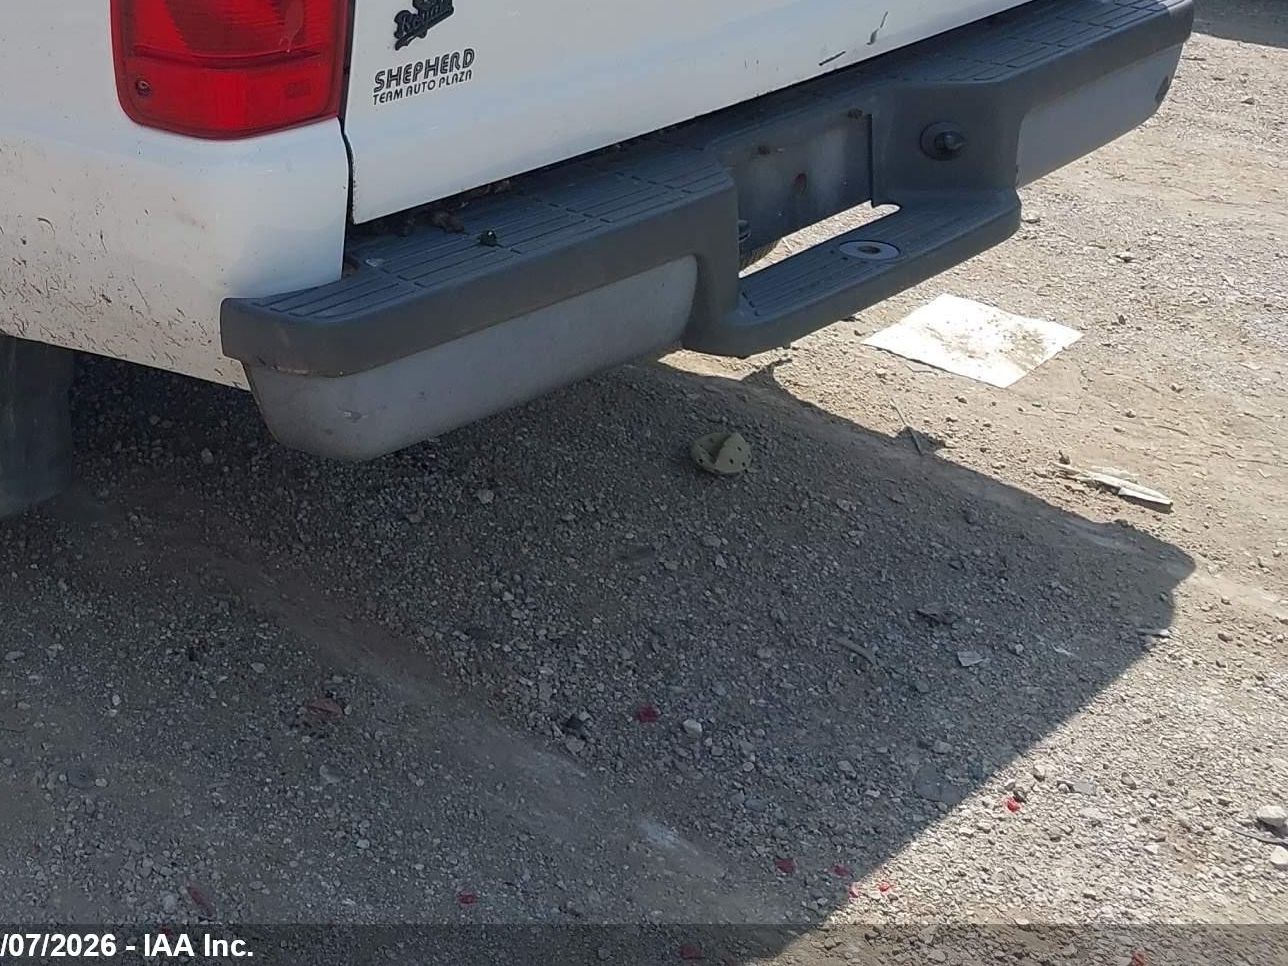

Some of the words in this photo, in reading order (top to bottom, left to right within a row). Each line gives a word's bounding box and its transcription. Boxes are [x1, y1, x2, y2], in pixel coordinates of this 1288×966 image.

[373, 48, 475, 93] SHEPHERD
[373, 87, 403, 105] TEAM
[406, 78, 435, 97] AUTO
[439, 69, 472, 88] PLAZA
